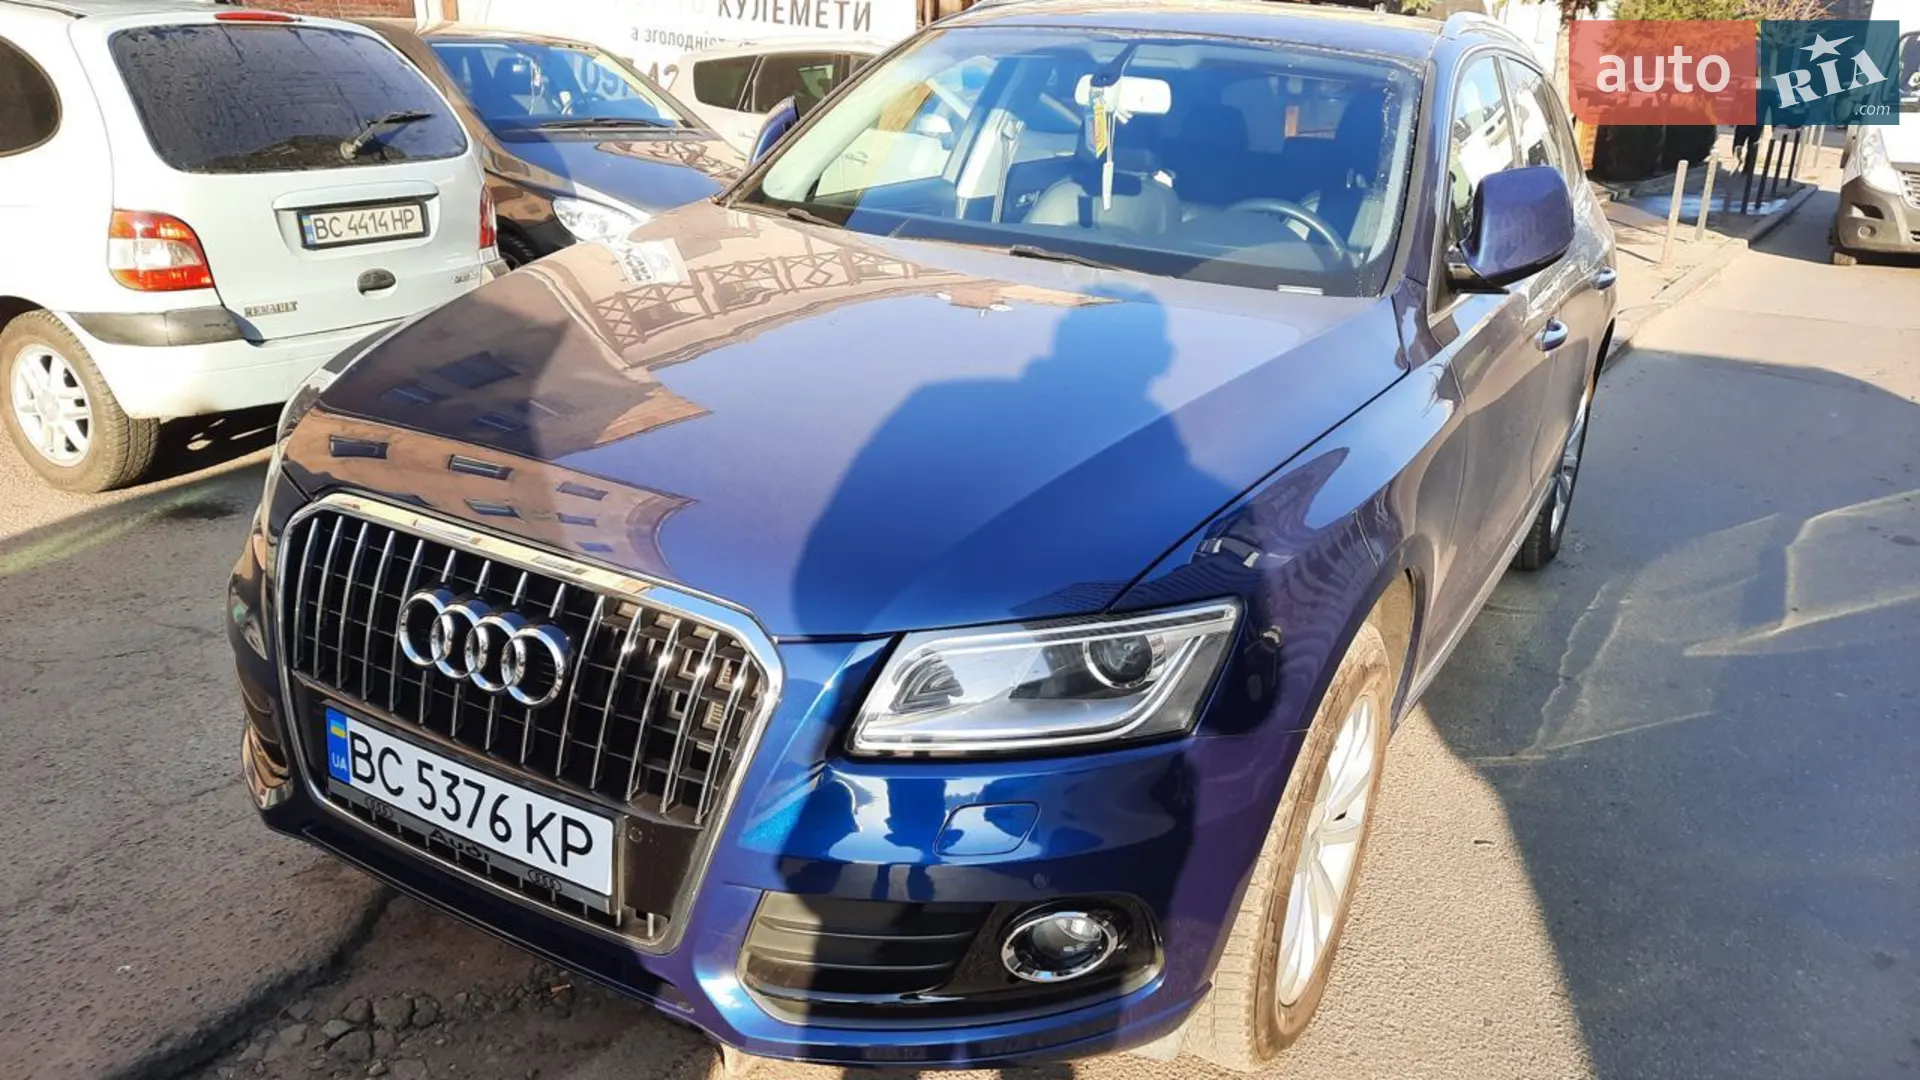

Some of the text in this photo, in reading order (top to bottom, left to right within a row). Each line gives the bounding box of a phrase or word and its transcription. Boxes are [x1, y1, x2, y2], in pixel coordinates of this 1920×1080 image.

[718, 0, 871, 32] КУЛЕМЕТИ
[313, 218, 343, 239] BC
[347, 211, 389, 236] 4414
[391, 208, 415, 231] HP
[243, 300, 298, 318] RENAULT
[331, 752, 347, 772] UA
[349, 729, 593, 868] BC 5376 KP
